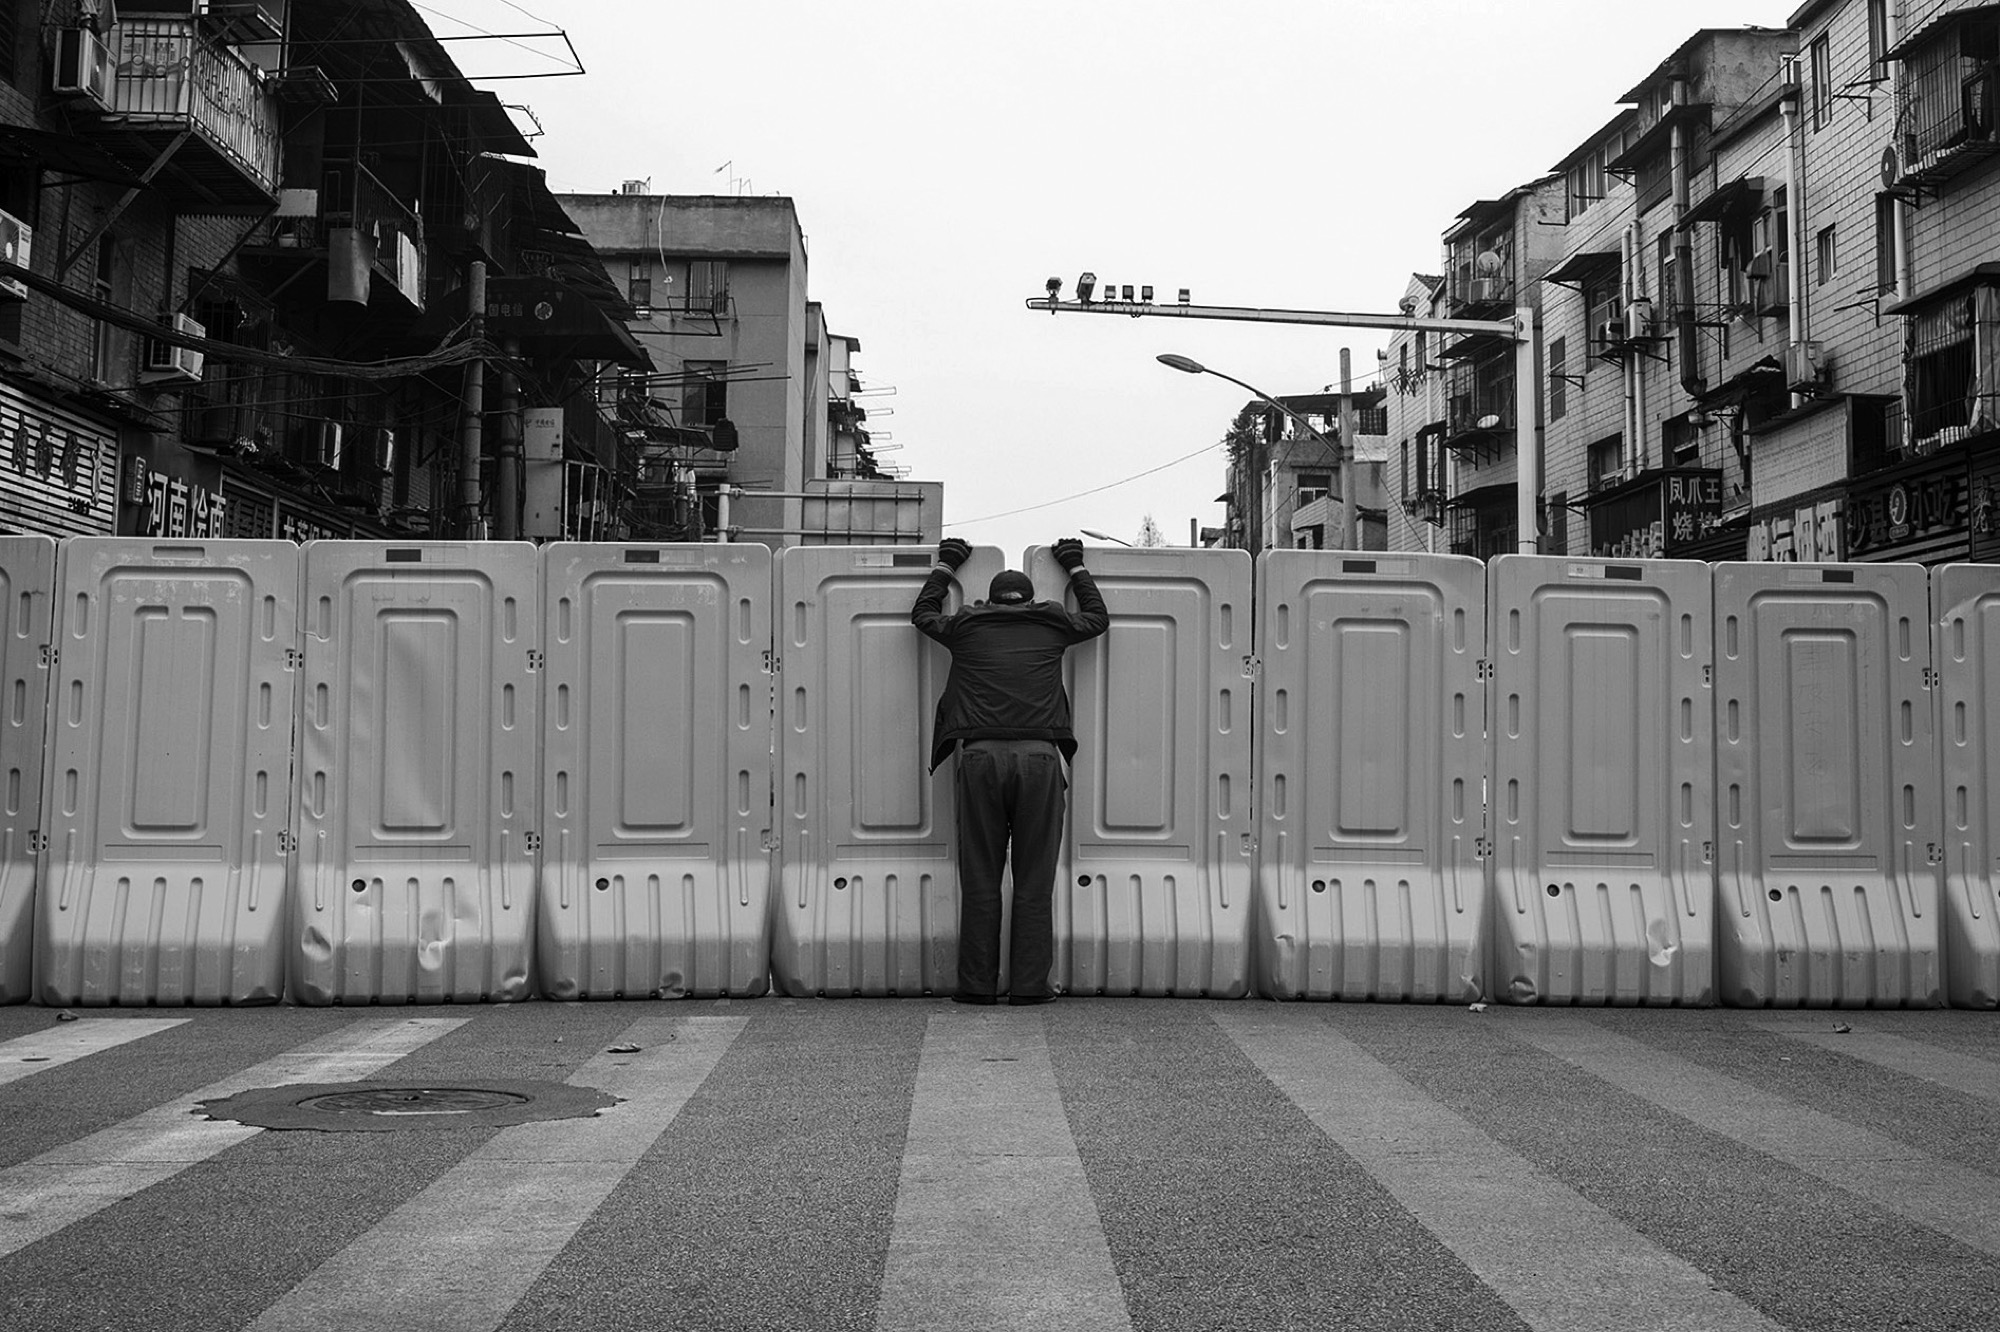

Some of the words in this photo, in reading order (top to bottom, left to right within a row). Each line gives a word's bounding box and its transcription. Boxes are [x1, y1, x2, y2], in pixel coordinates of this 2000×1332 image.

[488, 303, 523, 317] 国电信
[146, 470, 227, 538] 河南烩面
[1669, 476, 1720, 505] 凤爪王
